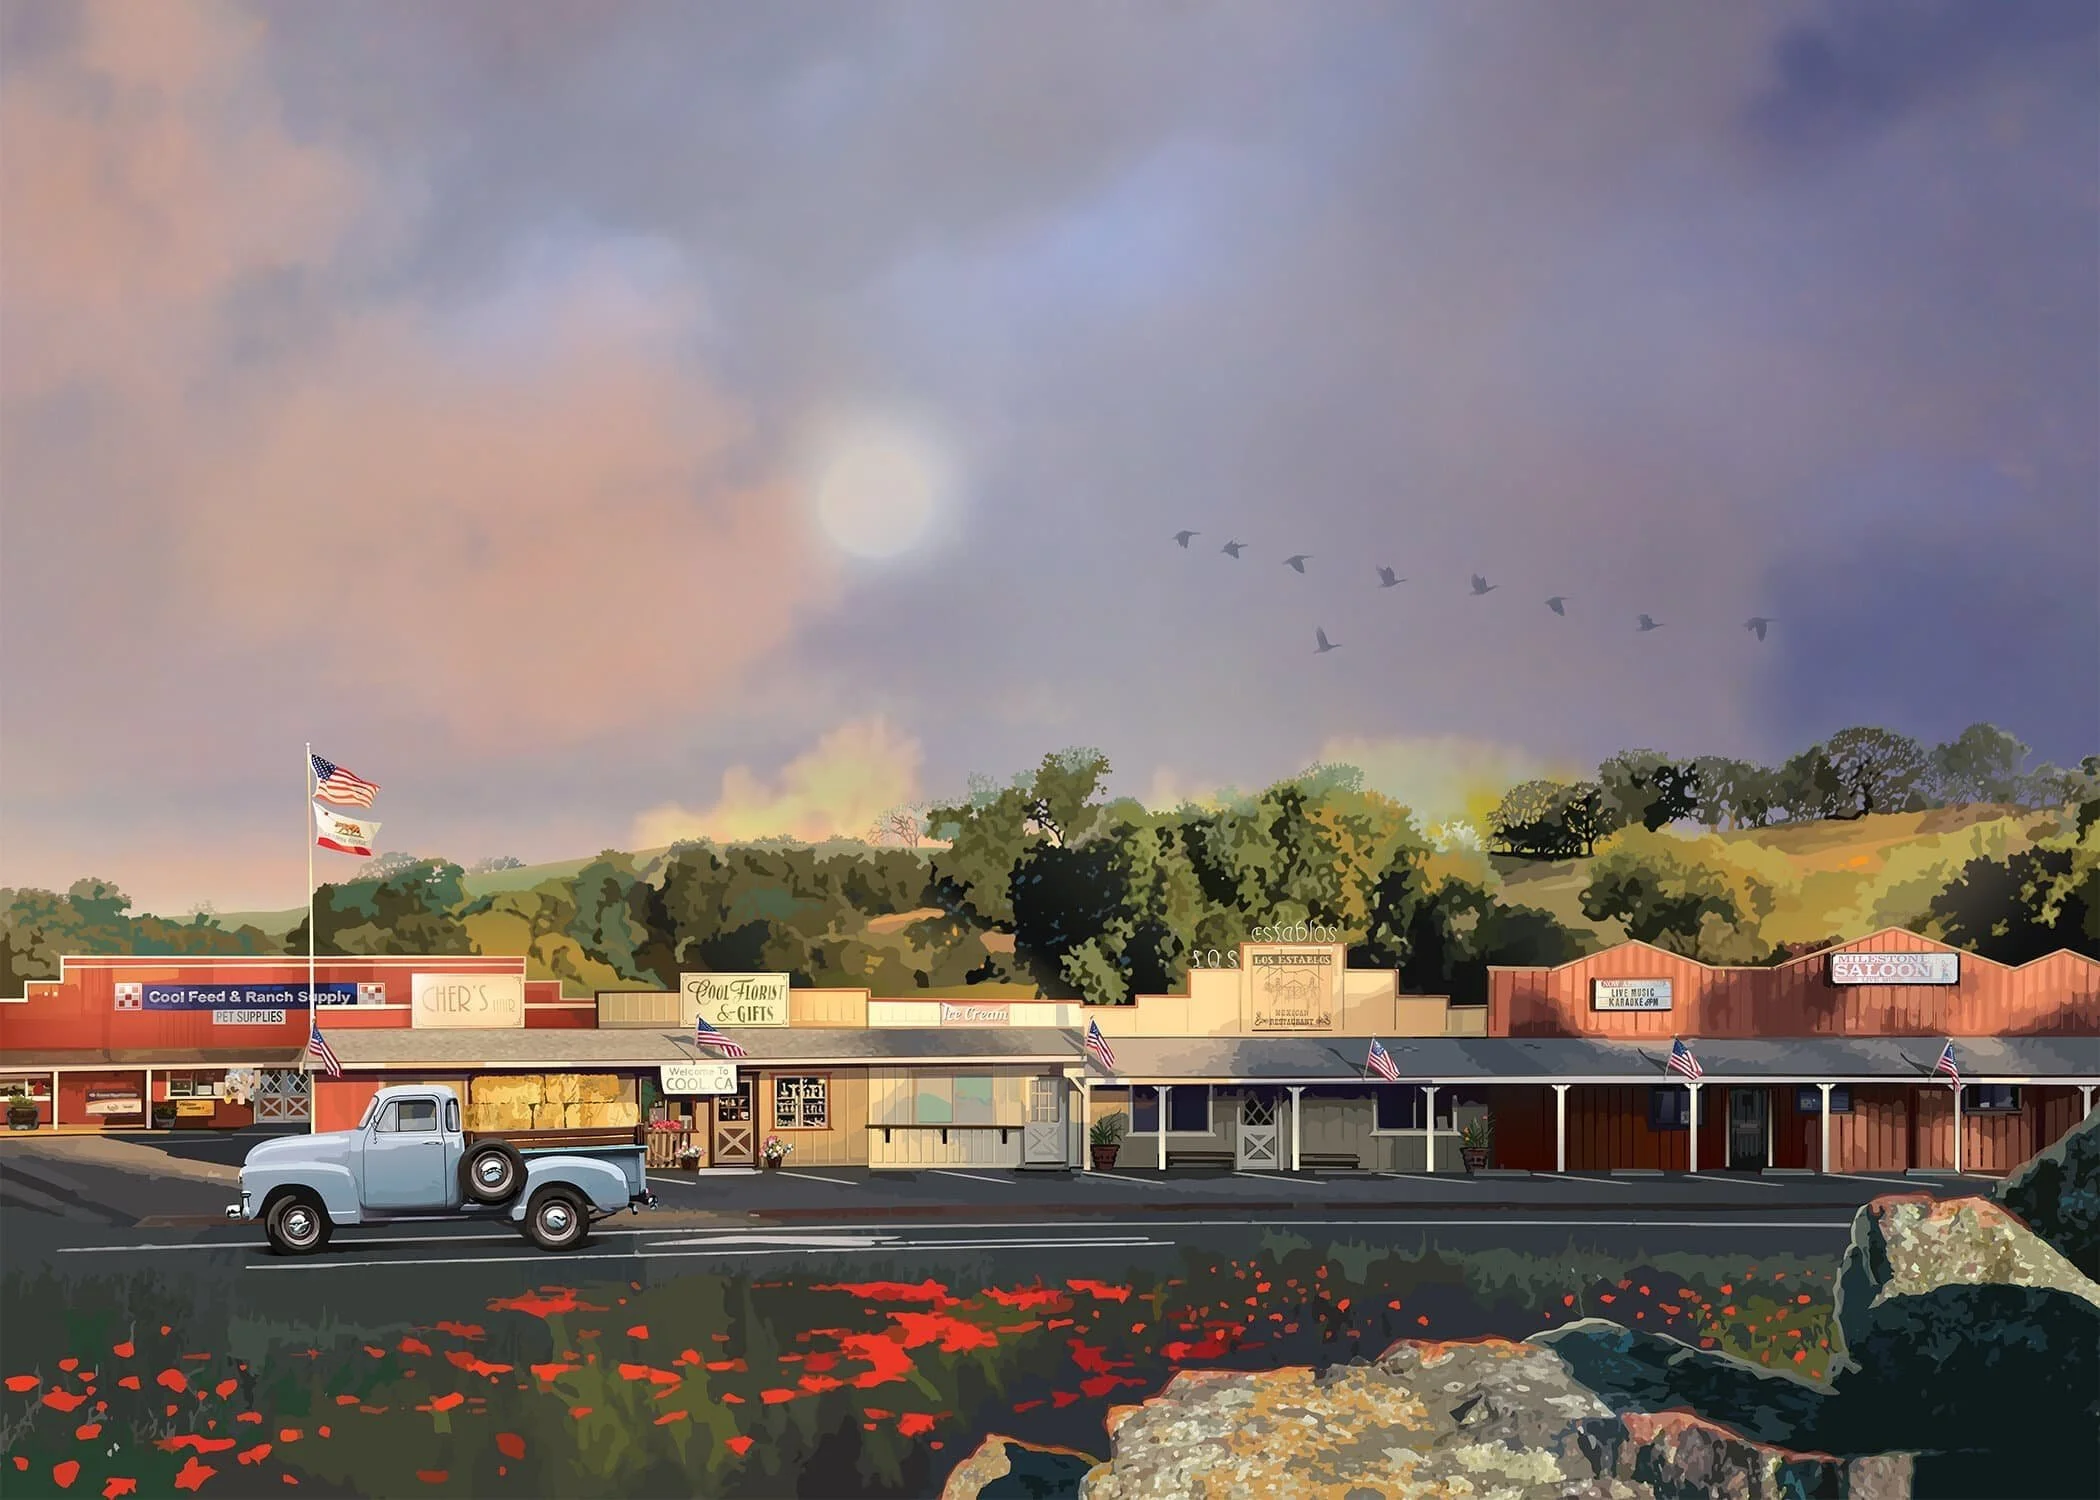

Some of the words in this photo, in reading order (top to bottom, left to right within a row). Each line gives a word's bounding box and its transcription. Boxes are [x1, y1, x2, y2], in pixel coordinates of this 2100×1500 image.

[1254, 955, 1274, 965] LOS
[1834, 963, 1932, 978] SALOON
[149, 990, 185, 1003] Cool
[188, 990, 226, 1003] Feed
[229, 990, 242, 1003] &
[245, 990, 294, 1003] Ranch
[297, 990, 351, 1006] Supply
[422, 984, 488, 1013] CHER'S
[1611, 988, 1629, 998] LIVE
[1631, 987, 1655, 998] MUSIC
[215, 1011, 234, 1023] PET
[236, 1011, 283, 1023] SUPPLIES
[737, 1006, 774, 1023] GIFTS
[966, 1007, 1009, 1021] Cream
[1275, 1009, 1309, 1017] MEXICAN
[718, 1066, 729, 1076] To
[714, 1077, 734, 1091] CA
